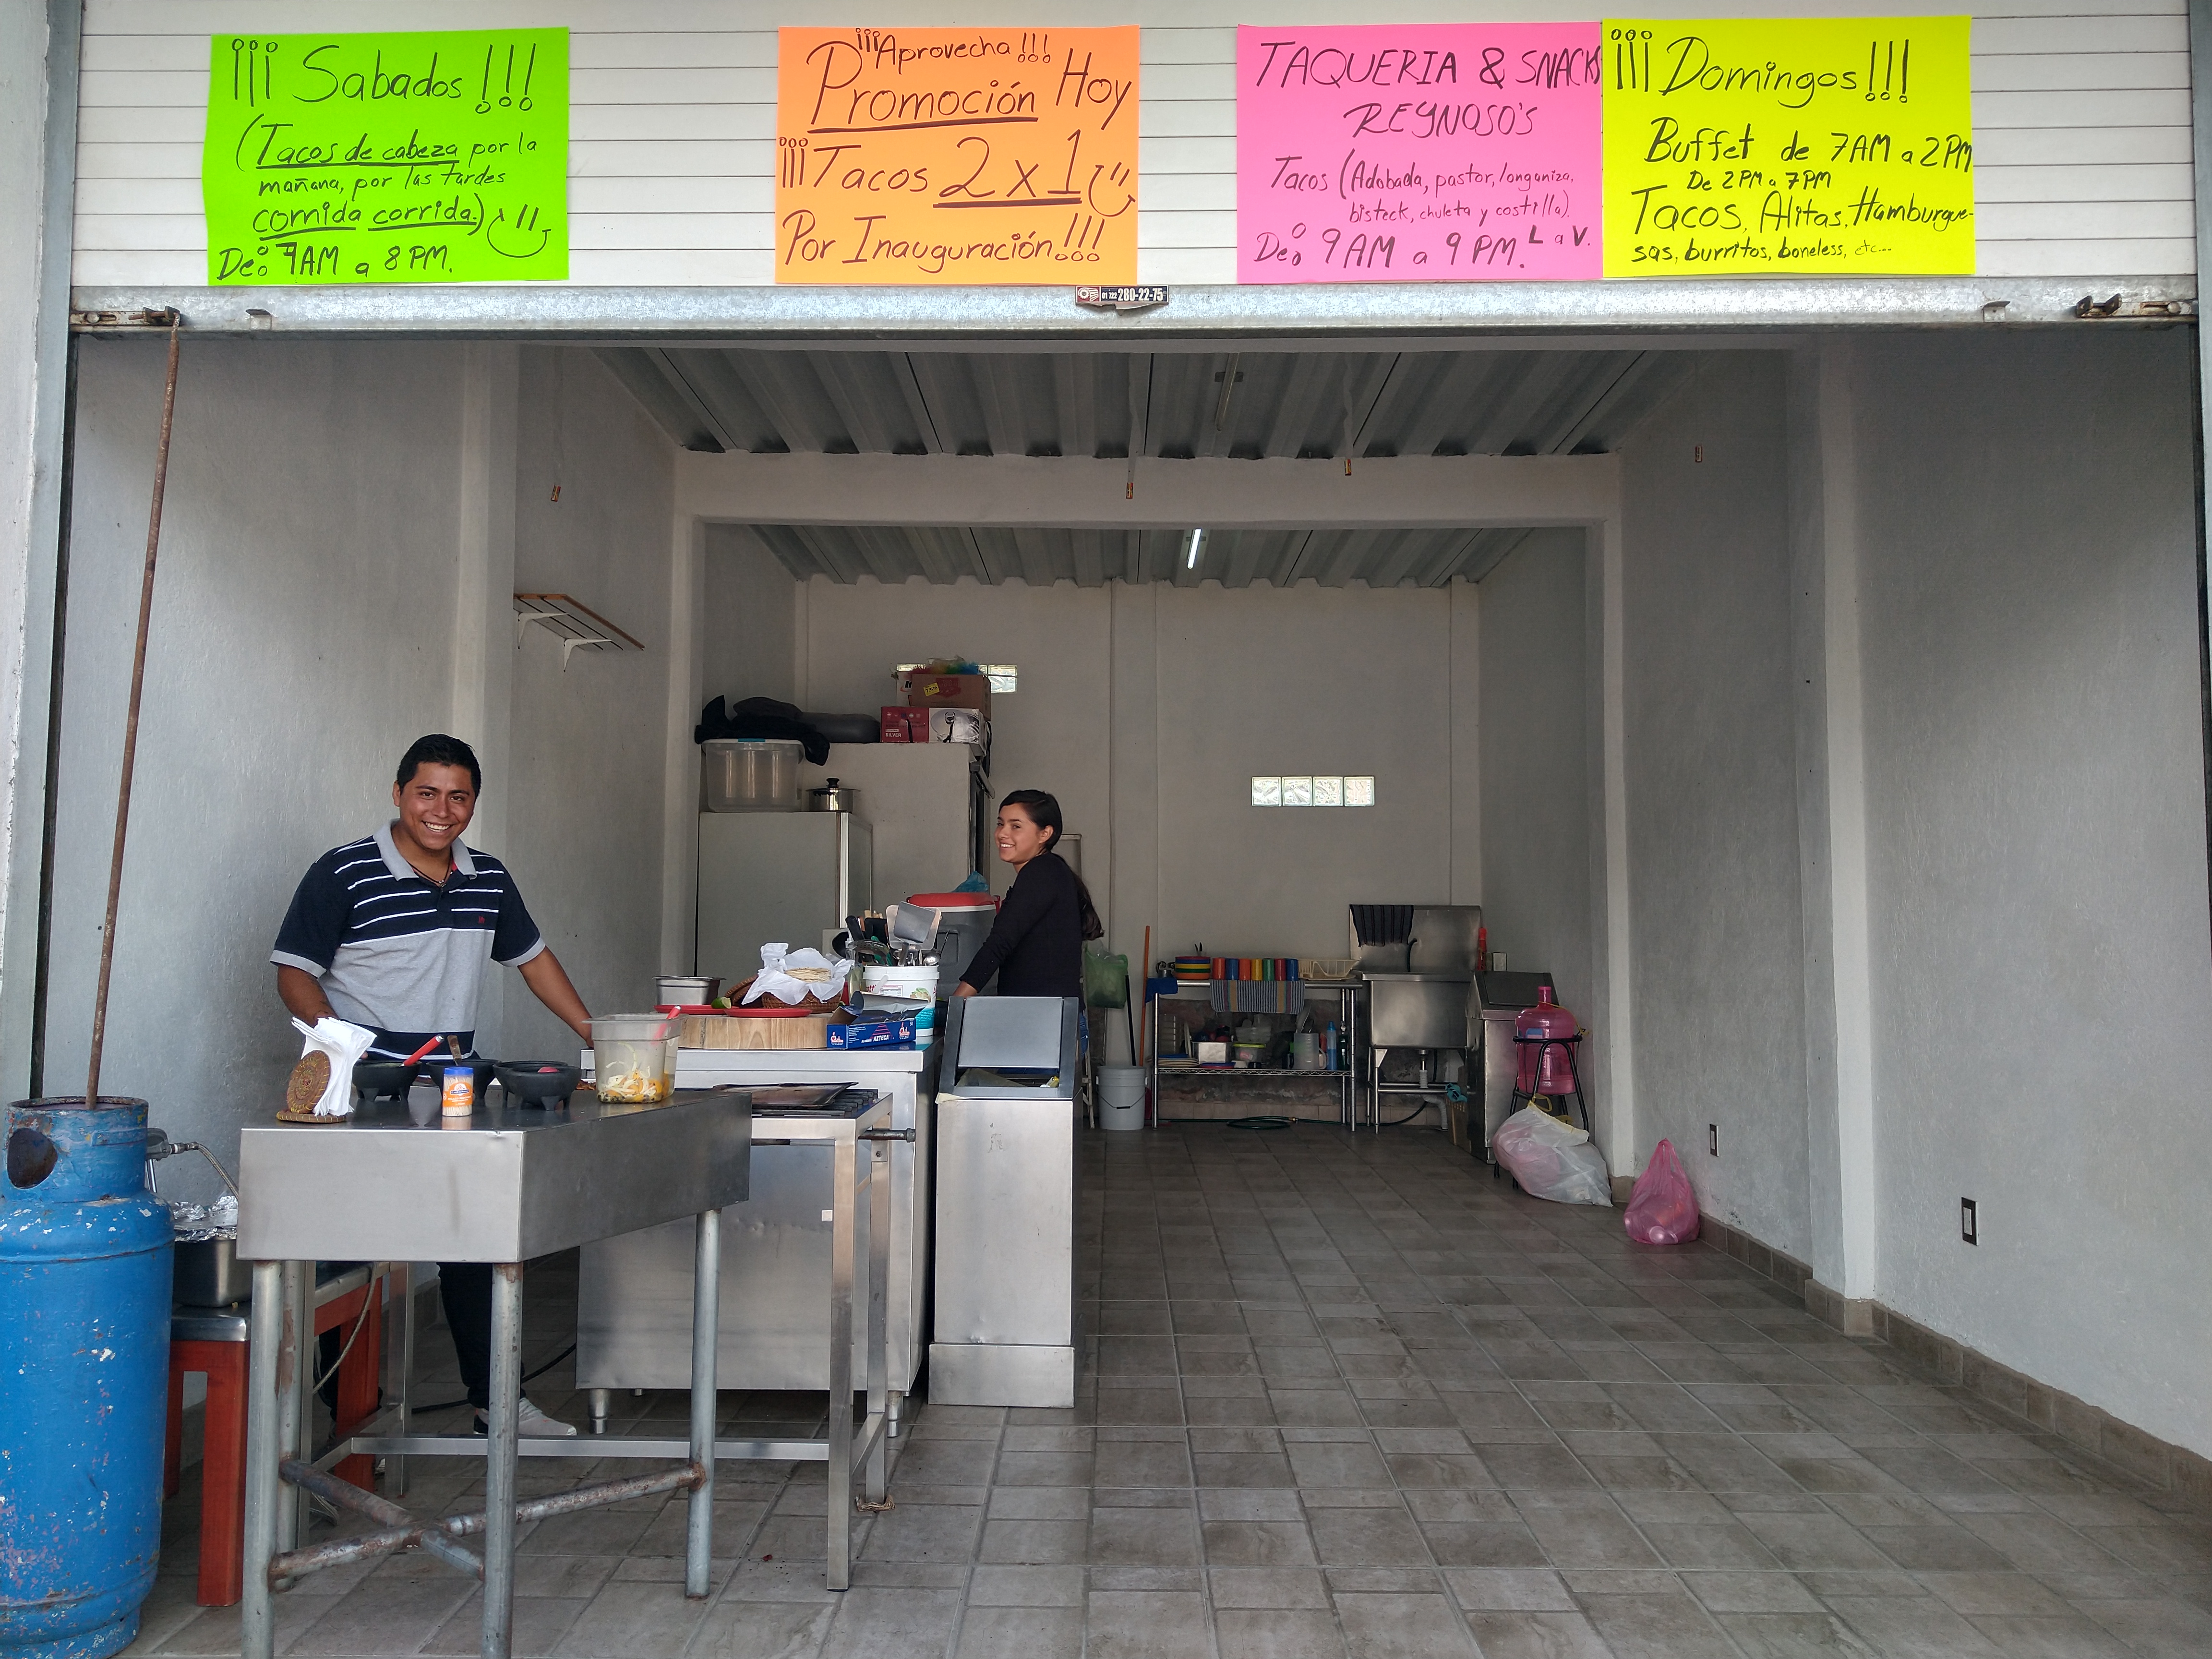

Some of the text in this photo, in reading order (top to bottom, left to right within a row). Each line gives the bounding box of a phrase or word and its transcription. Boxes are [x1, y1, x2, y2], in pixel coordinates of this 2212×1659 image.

[1257, 41, 1601, 89] TAQUERIA & SNACKS
[806, 41, 1132, 130] Promoción Hoy
[1343, 101, 1538, 138] REYNOSO'S
[345, 132, 372, 161] de
[382, 129, 457, 160] cabeza
[470, 143, 509, 164] por
[518, 132, 536, 155] la
[1644, 117, 1755, 163] Buffet
[1780, 130, 1810, 162] de
[1901, 149, 1911, 163] a
[939, 136, 995, 198] 2
[1047, 129, 1082, 194] 1
[1271, 155, 1328, 190] Tacos
[1435, 162, 1494, 198] pastor,
[1499, 162, 1574, 193] longaniza,
[1686, 170, 1712, 191] De
[1769, 179, 1777, 187] a
[258, 165, 505, 202] mañana, por las tardes
[252, 201, 361, 233] comida
[1349, 199, 1414, 223] bisteck,
[1419, 200, 1471, 219] chuleta
[1479, 207, 1488, 226] y
[782, 209, 836, 265] Por
[1528, 224, 1543, 245] L
[1554, 233, 1563, 245] a
[1634, 243, 1678, 264] sas,
[1685, 236, 1772, 263] burritos,
[1779, 237, 1847, 259] boneless,
[355, 263, 369, 276] a
[1413, 250, 1428, 264] a
[1118, 288, 1164, 301] 280-22-75
